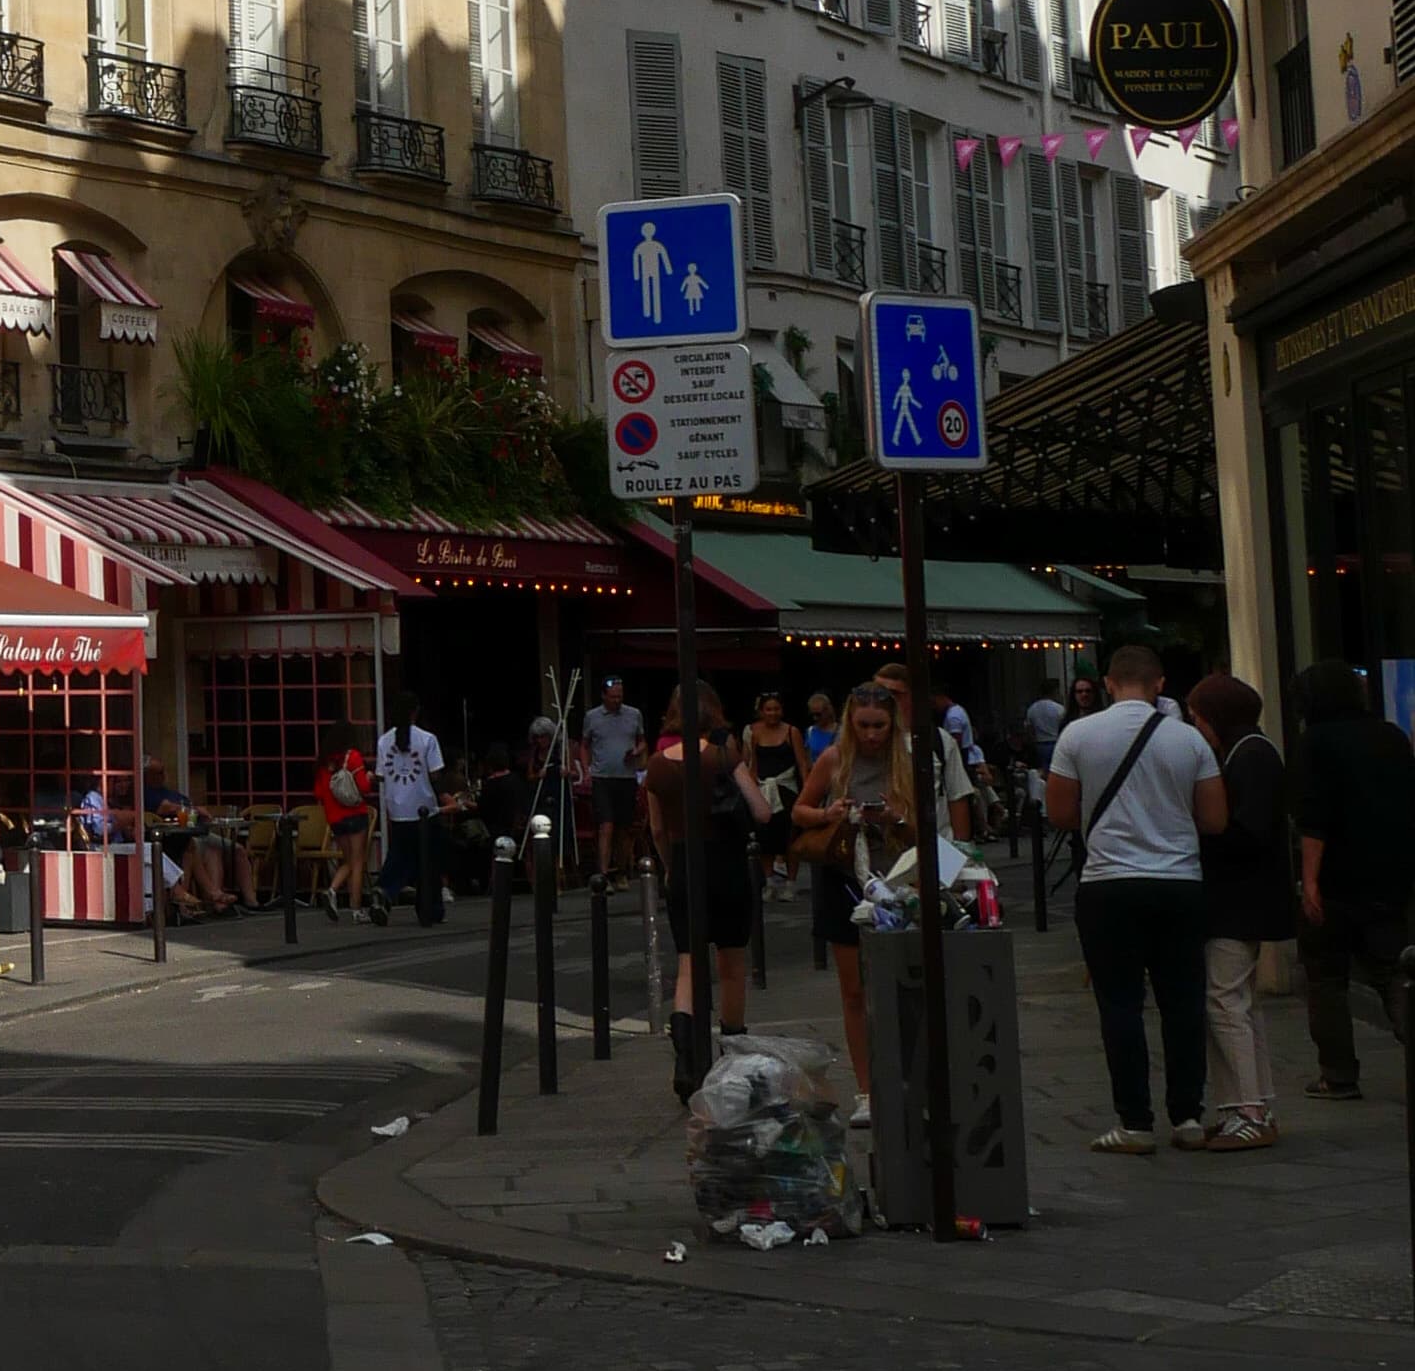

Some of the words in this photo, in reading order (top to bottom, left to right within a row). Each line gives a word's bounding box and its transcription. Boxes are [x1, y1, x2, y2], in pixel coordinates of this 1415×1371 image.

[1109, 21, 1218, 50] PAUL
[1, 303, 41, 316] BAKERY
[112, 313, 149, 327] COFFEE
[674, 352, 731, 363] CIRCULATION
[680, 365, 726, 376] INTERDITE
[691, 379, 715, 389] SAUF
[663, 391, 709, 404] DESSERTE
[711, 390, 745, 401] LOCALE
[669, 415, 742, 428] STATIONNEMENT
[945, 416, 962, 433] 20
[688, 432, 724, 443] GÊNANT
[677, 450, 701, 460] SAUF
[704, 448, 738, 459] CYCLES
[625, 478, 683, 493] ROULEZ
[689, 476, 708, 489] AU
[714, 475, 742, 488] PAS
[416, 537, 435, 565] Le
[476, 543, 489, 567] de
[491, 542, 518, 569] Buci
[45, 637, 64, 662] de
[70, 635, 102, 662] Thé
